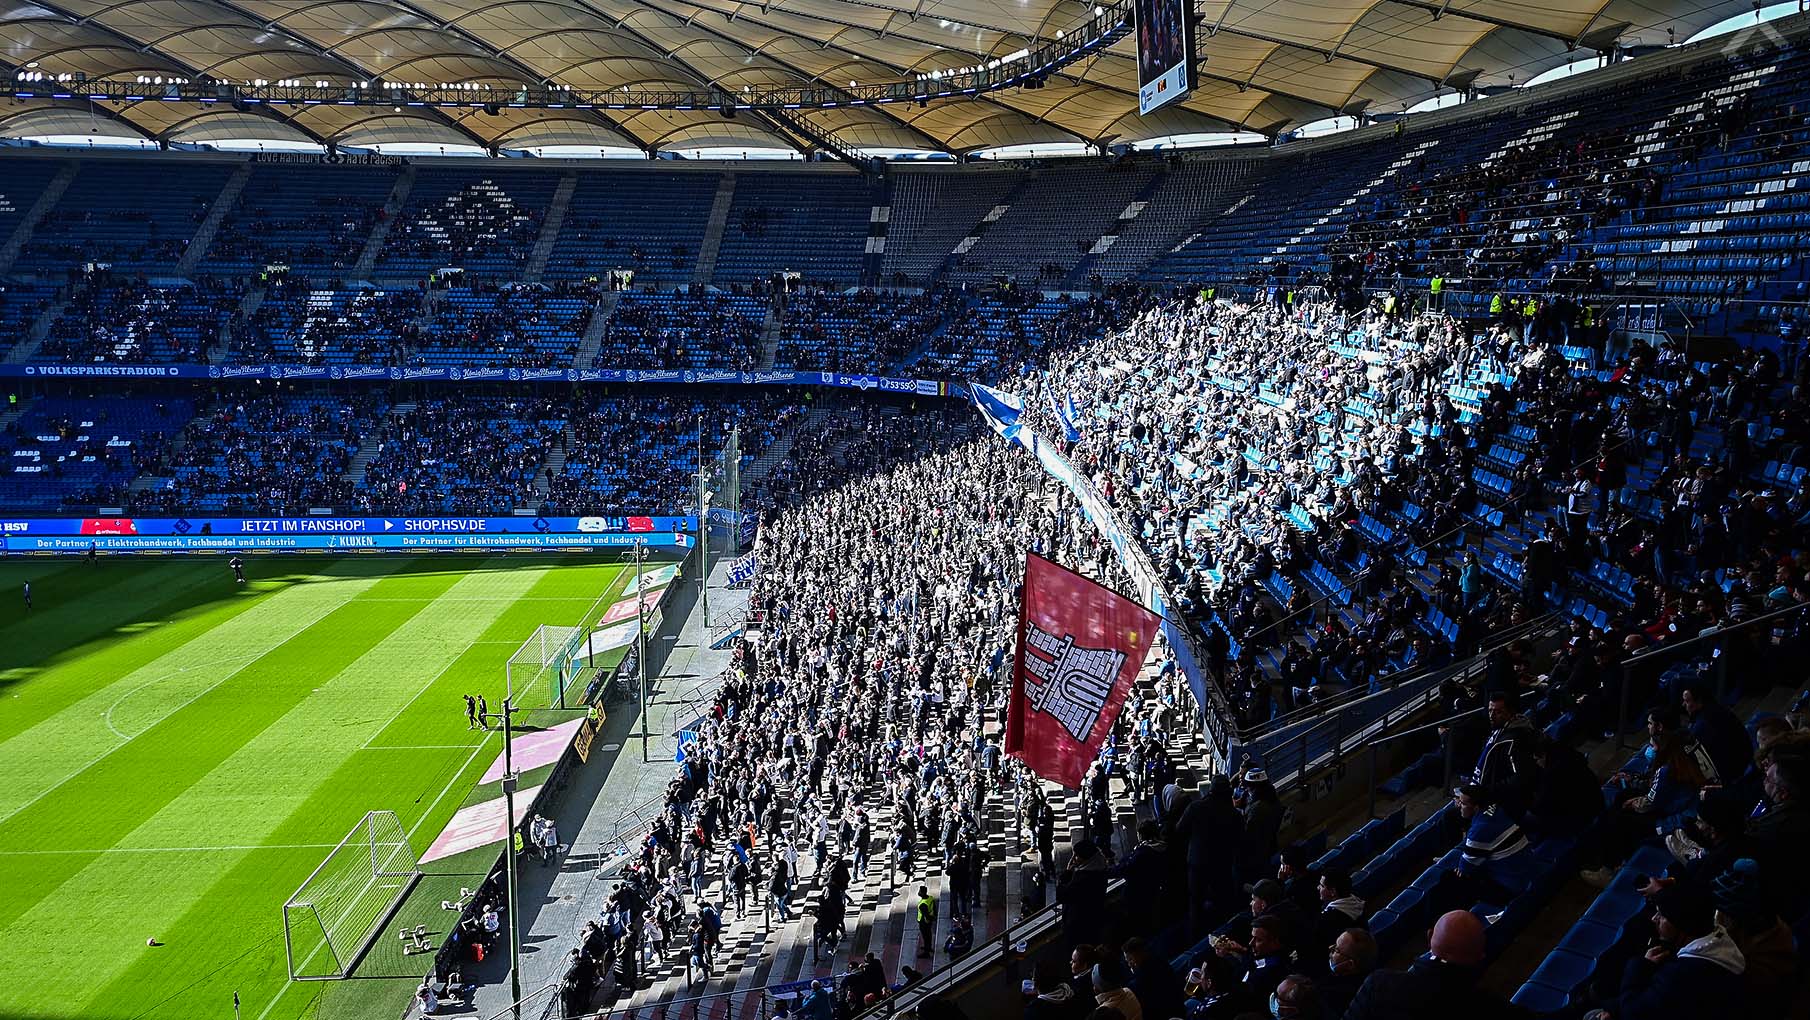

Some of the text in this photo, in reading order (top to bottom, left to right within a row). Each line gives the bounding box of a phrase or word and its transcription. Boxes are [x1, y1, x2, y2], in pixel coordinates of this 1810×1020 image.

[39, 366, 165, 375] VOLKSPARKSTADION
[4, 523, 28, 531] HSV
[241, 519, 366, 532] JETZT IM FANSHOP!
[404, 519, 486, 530] SHOP.HSV.DE
[37, 539, 52, 547] Der
[56, 539, 89, 547] Partner
[107, 538, 185, 548] Elektrohandwerk,
[188, 538, 235, 546] Fachhandel
[239, 538, 254, 546] und
[257, 537, 296, 546] Industrie
[340, 536, 373, 546] KLUXEN
[403, 537, 417, 545] Der
[420, 537, 451, 545] Partner
[454, 536, 467, 545] für
[469, 536, 543, 546] Elektrohandwerk,
[545, 535, 592, 544] Fachhandel
[594, 536, 609, 544] und
